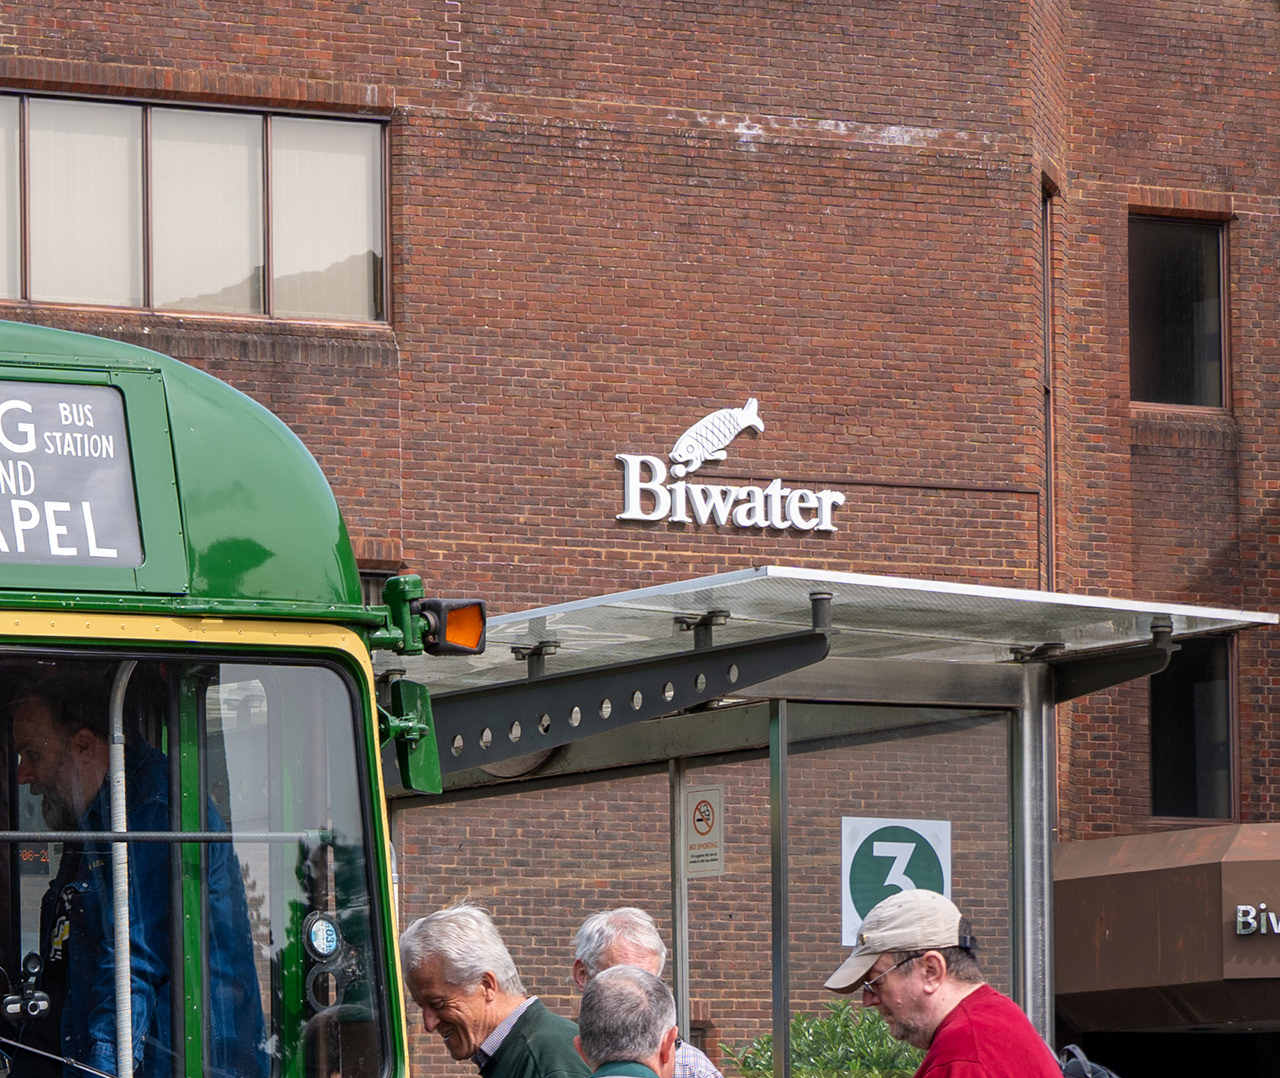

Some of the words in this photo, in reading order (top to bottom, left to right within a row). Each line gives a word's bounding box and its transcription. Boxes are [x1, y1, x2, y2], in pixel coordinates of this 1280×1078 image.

[58, 402, 95, 429] BUS
[44, 431, 115, 459] STATION
[616, 452, 846, 533] Biwater
[873, 841, 916, 891] 3
